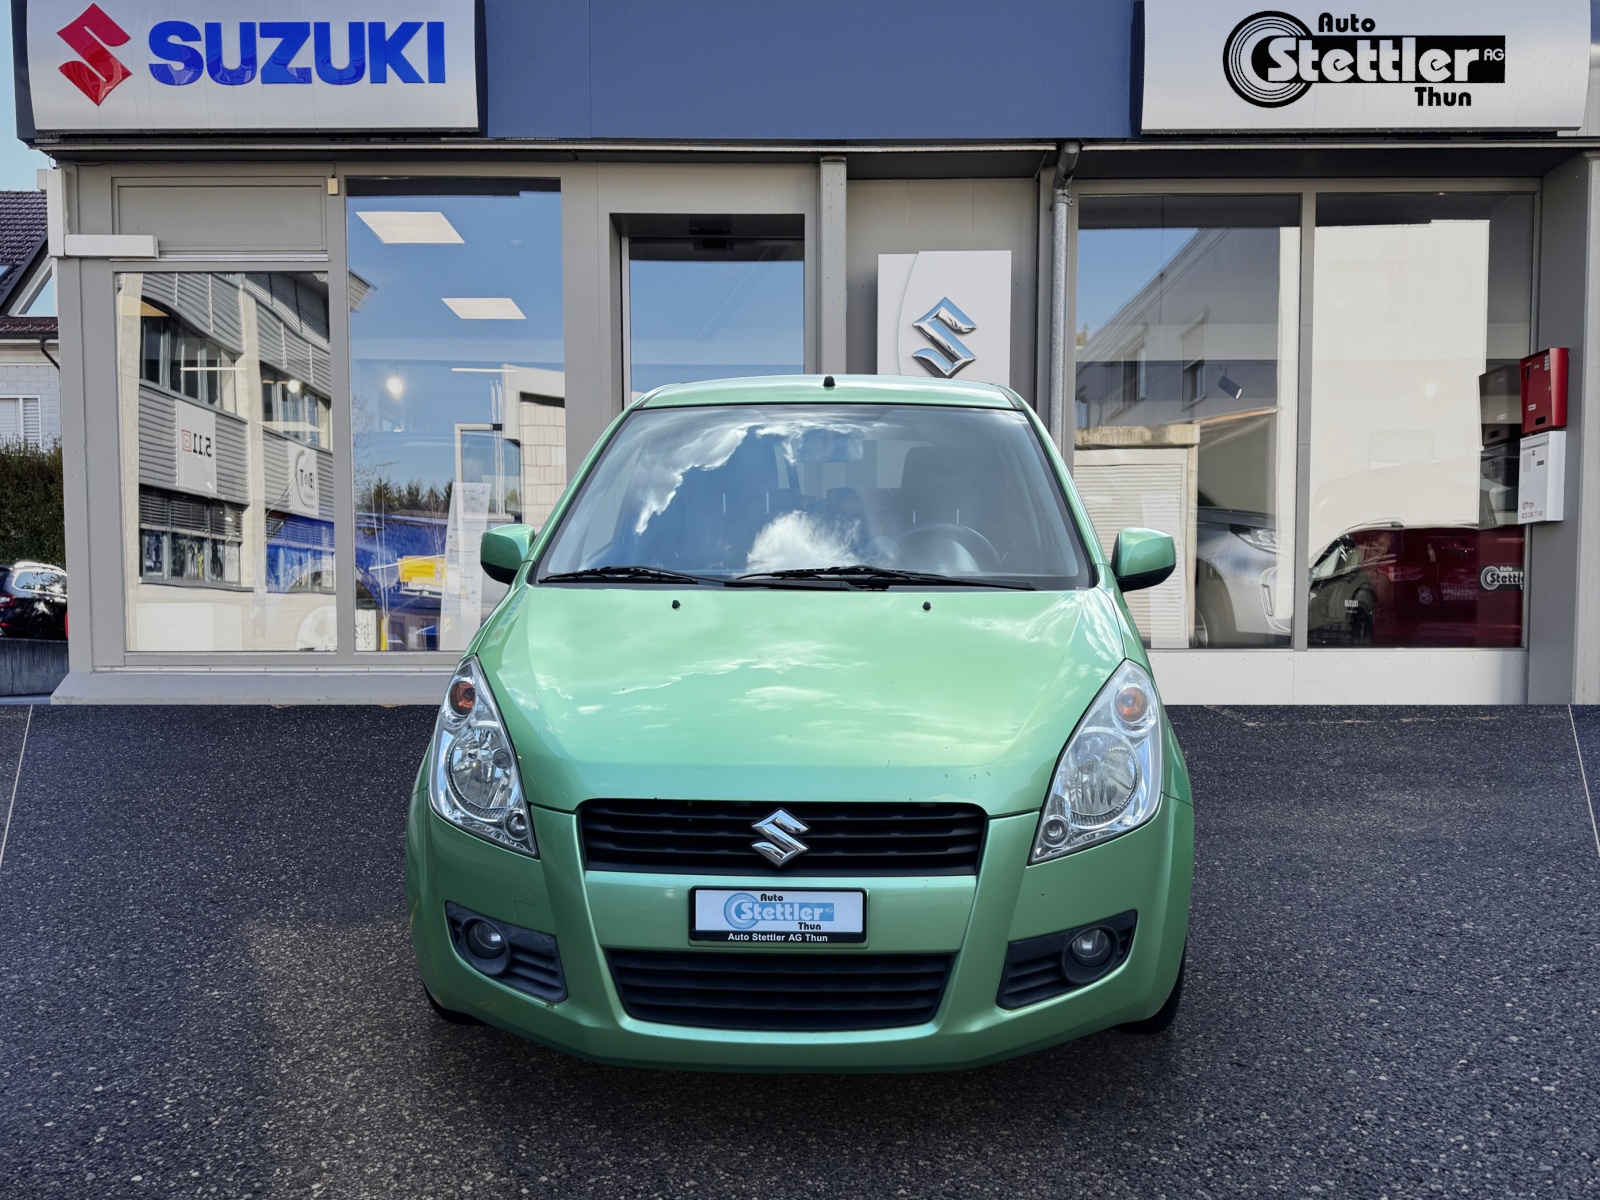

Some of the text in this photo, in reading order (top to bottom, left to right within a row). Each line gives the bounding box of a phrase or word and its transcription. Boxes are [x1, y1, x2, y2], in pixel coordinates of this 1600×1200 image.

[1318, 12, 1376, 33] Auto
[148, 20, 446, 86] SUZUKI
[1267, 37, 1505, 82] Stettler AG
[1414, 86, 1472, 107] Thun
[760, 893, 784, 902] Auto
[740, 902, 824, 921] Stettler
[797, 922, 822, 931] Thun
[727, 932, 828, 942] Auto Stettler AG Thun
